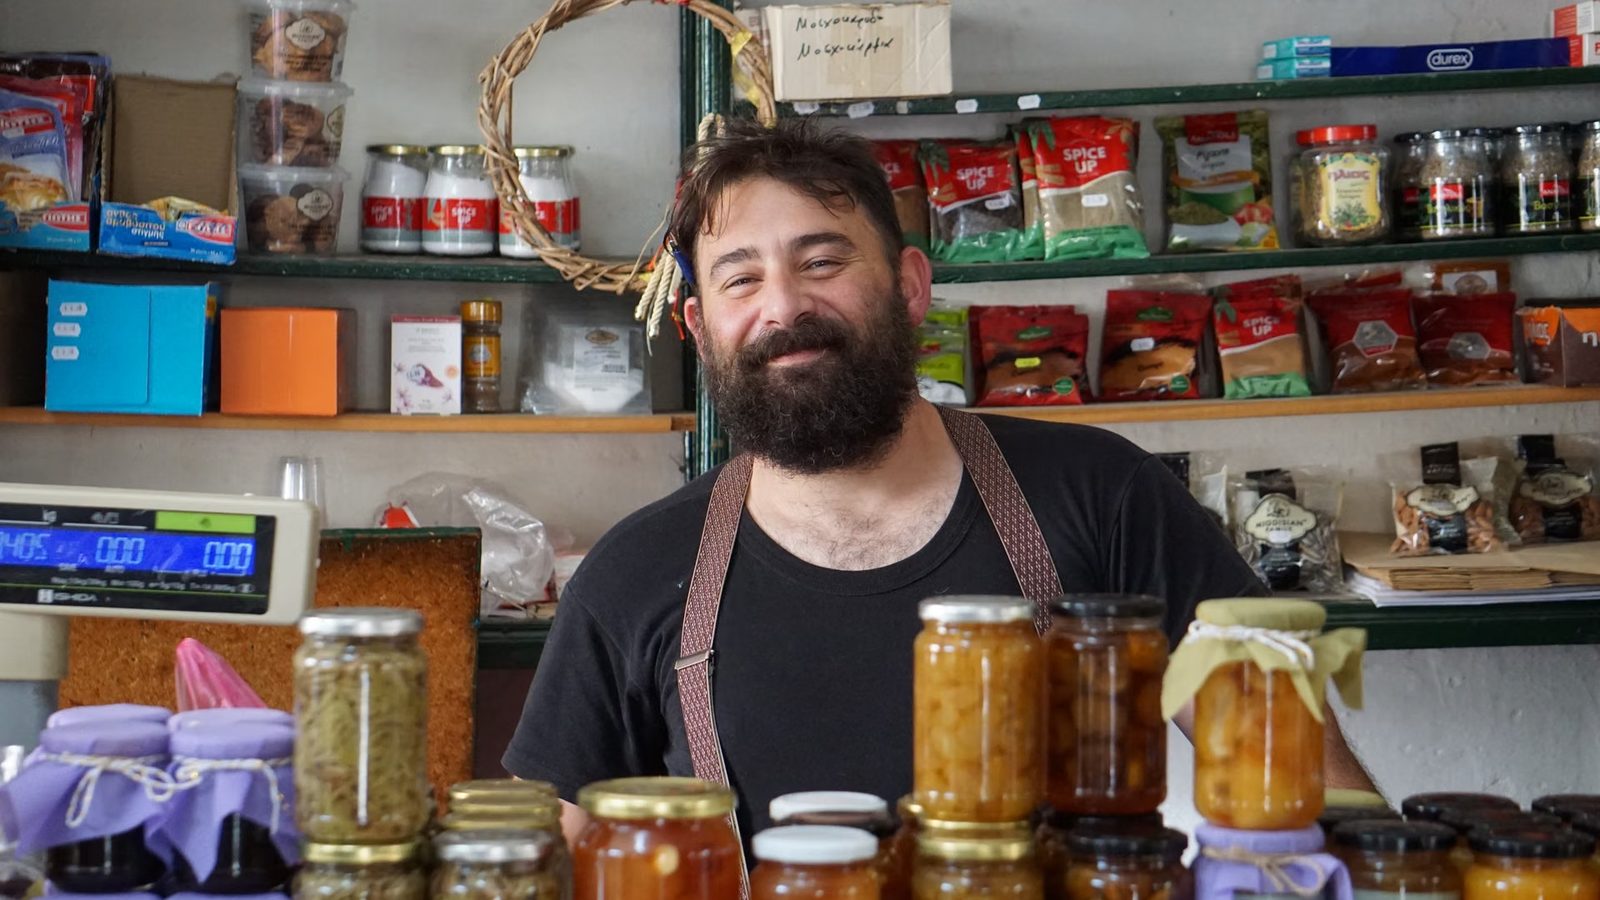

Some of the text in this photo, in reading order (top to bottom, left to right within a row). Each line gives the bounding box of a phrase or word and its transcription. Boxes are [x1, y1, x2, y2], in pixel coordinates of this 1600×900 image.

[1430, 51, 1471, 66] durex
[1063, 146, 1107, 162] SPICE
[956, 166, 994, 181] SPICE
[1074, 159, 1098, 174] UP
[966, 178, 987, 190] UP
[451, 206, 477, 218] SPICE
[457, 214, 472, 224] UP
[1242, 315, 1280, 329] SPICE
[1252, 324, 1272, 337] UP
